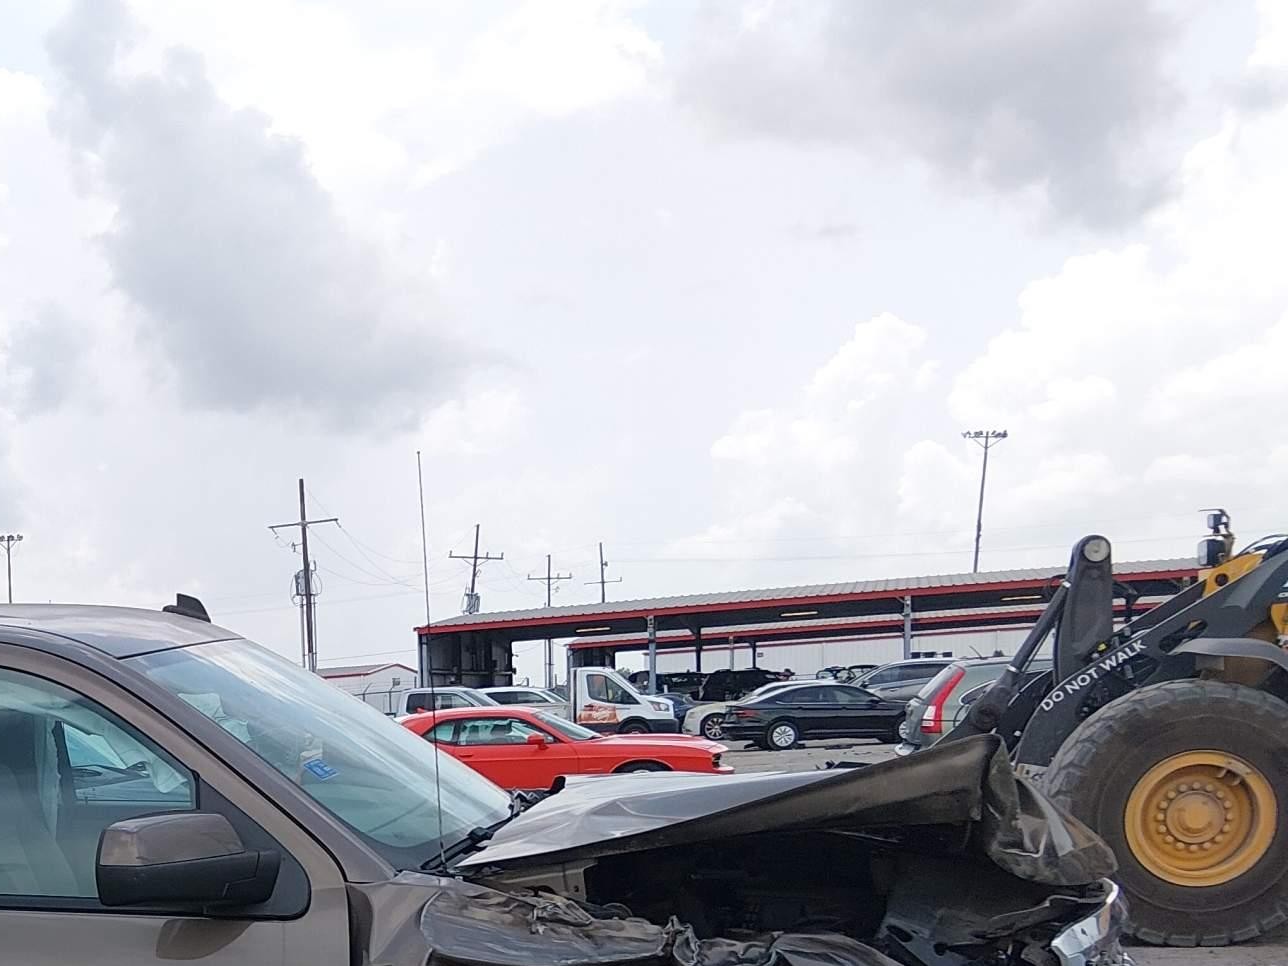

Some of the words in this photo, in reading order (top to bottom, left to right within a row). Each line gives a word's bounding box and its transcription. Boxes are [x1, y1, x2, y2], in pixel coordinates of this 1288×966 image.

[1040, 691, 1064, 711] DO
[1065, 667, 1099, 694] NOT
[1099, 640, 1147, 671] WALK
